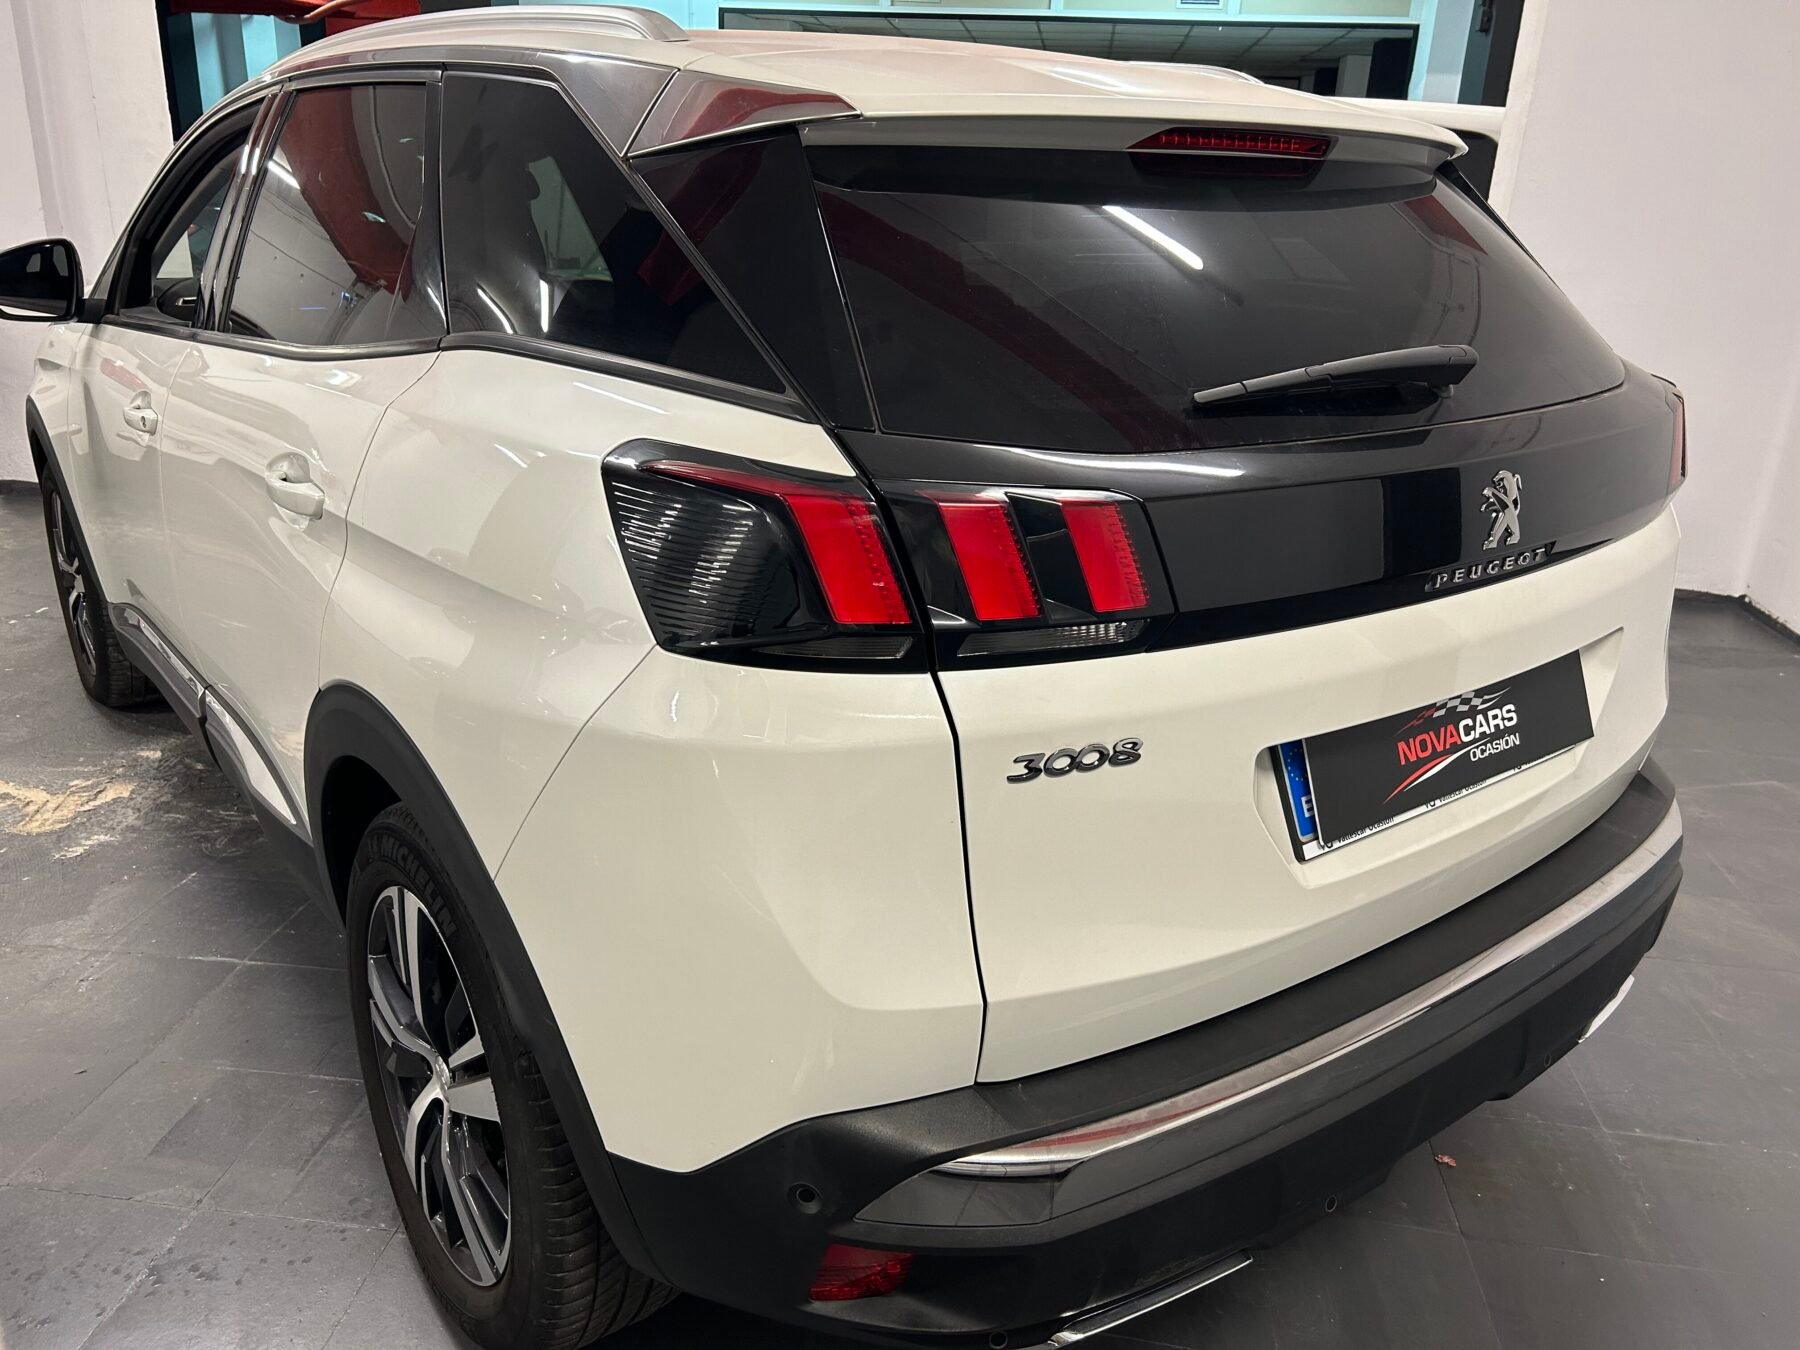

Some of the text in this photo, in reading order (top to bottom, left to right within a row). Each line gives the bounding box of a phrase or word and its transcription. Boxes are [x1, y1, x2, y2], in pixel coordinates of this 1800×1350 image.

[1434, 547, 1547, 589] PEUGEOT
[1396, 703, 1518, 766] NOVACARS
[1469, 732, 1521, 762] OCASIÓN
[1006, 737, 1144, 784] 3008
[1300, 795, 1315, 818] E
[381, 832, 457, 938] MICHELIN
